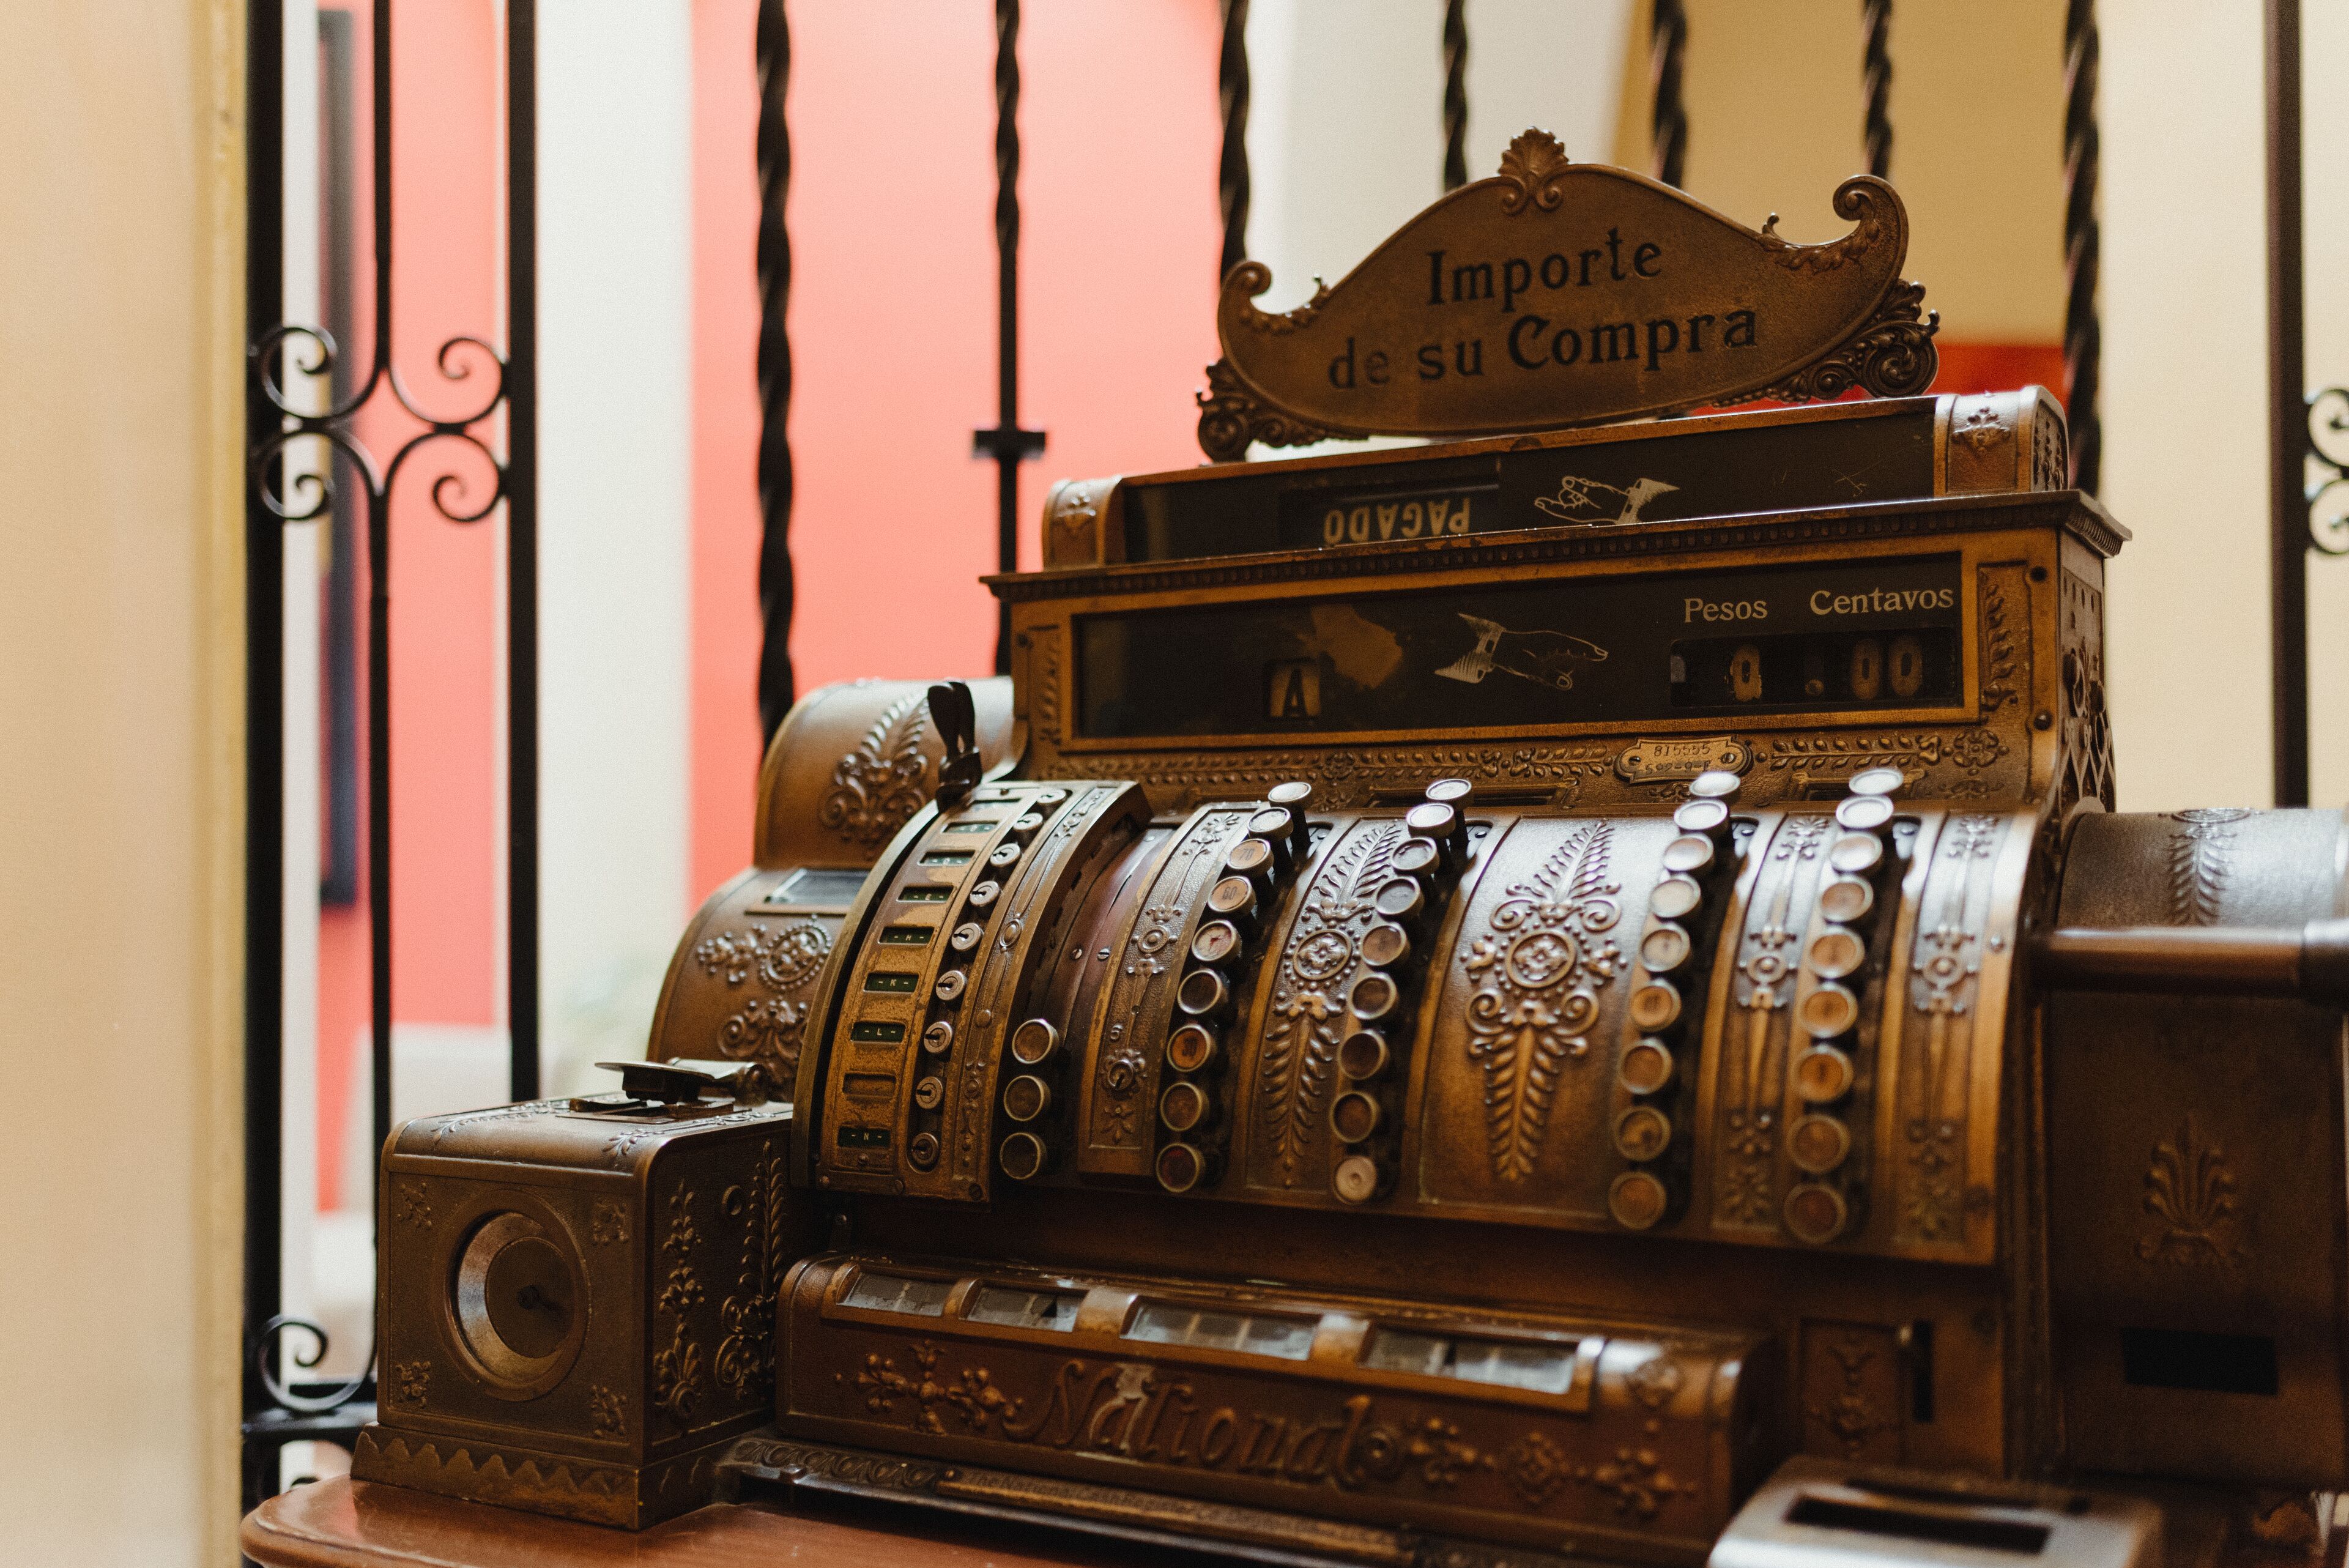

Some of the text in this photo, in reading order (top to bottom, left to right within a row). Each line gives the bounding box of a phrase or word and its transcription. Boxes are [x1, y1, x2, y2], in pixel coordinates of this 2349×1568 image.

[1426, 228, 1663, 313] Importe
[1328, 308, 1757, 390] de su Compra
[1323, 497, 1471, 543] PAGADO
[1684, 587, 1954, 623] Pesos Centavos
[1282, 666, 1309, 718] A
[1003, 1358, 1373, 1492] National
